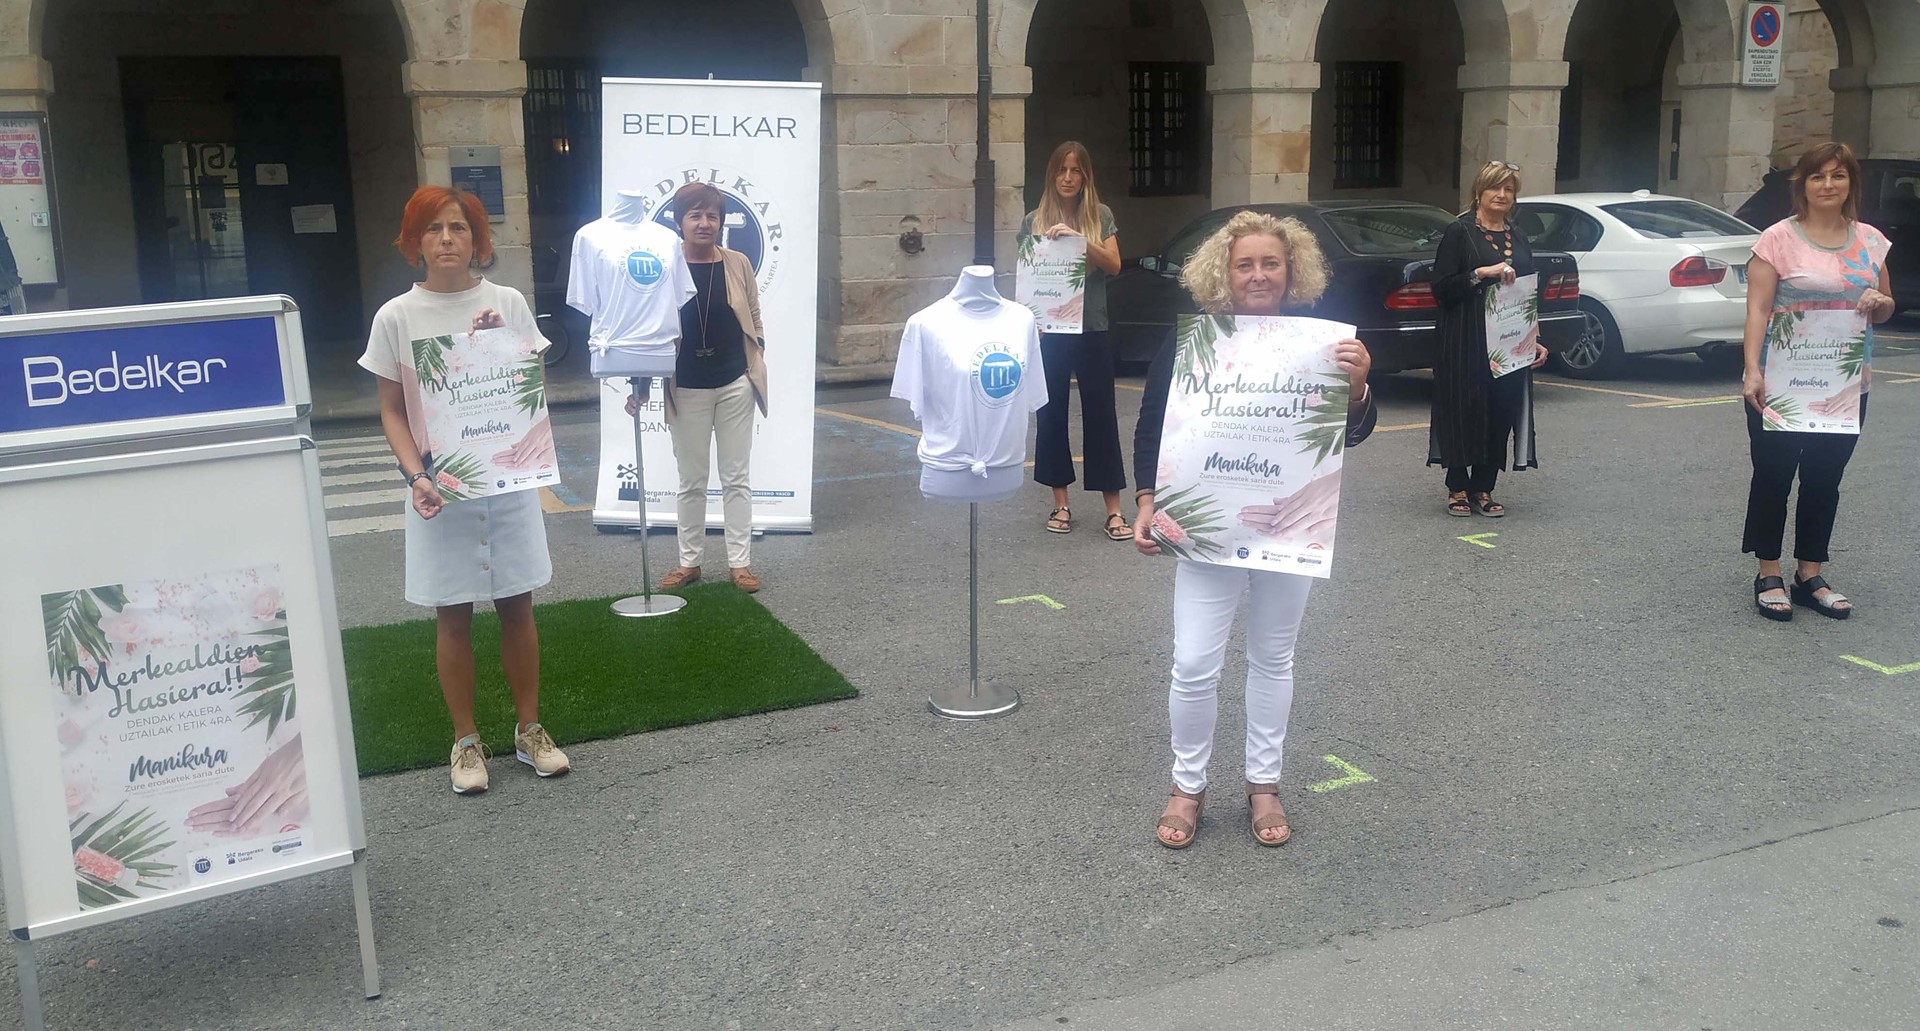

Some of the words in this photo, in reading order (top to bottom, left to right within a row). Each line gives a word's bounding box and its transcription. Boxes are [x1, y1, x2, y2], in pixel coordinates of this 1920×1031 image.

[623, 113, 797, 139] BEDELKAR
[643, 168, 783, 242] EDELKAR
[1777, 338, 1853, 351] Merkealdien
[22, 351, 227, 407] Bedelkar
[426, 366, 526, 394] Merkealdien
[1182, 373, 1329, 396] Merkealdien
[449, 379, 517, 406] Hasiera!!
[1201, 396, 1307, 418] Hasiera!!
[461, 419, 511, 439] Manikura
[1204, 431, 1245, 441] UZTAILAK
[1272, 436, 1291, 445] 4RA
[1211, 421, 1248, 431] DENDAK
[1250, 425, 1285, 434] KALERA
[1204, 452, 1282, 478] Manikura
[1216, 473, 1249, 482] erosketek
[67, 641, 267, 696] Merkealdien
[108, 665, 244, 719] Hasiera!!
[119, 726, 174, 743] UZTAILAK
[210, 715, 232, 728] 4RA
[126, 713, 177, 729] DENDAK
[178, 705, 223, 721] KALERA
[128, 743, 228, 783] Manikura
[124, 783, 146, 793] Zure
[147, 774, 191, 788] erosketek
[192, 770, 213, 780] saria
[214, 765, 235, 775] dute
